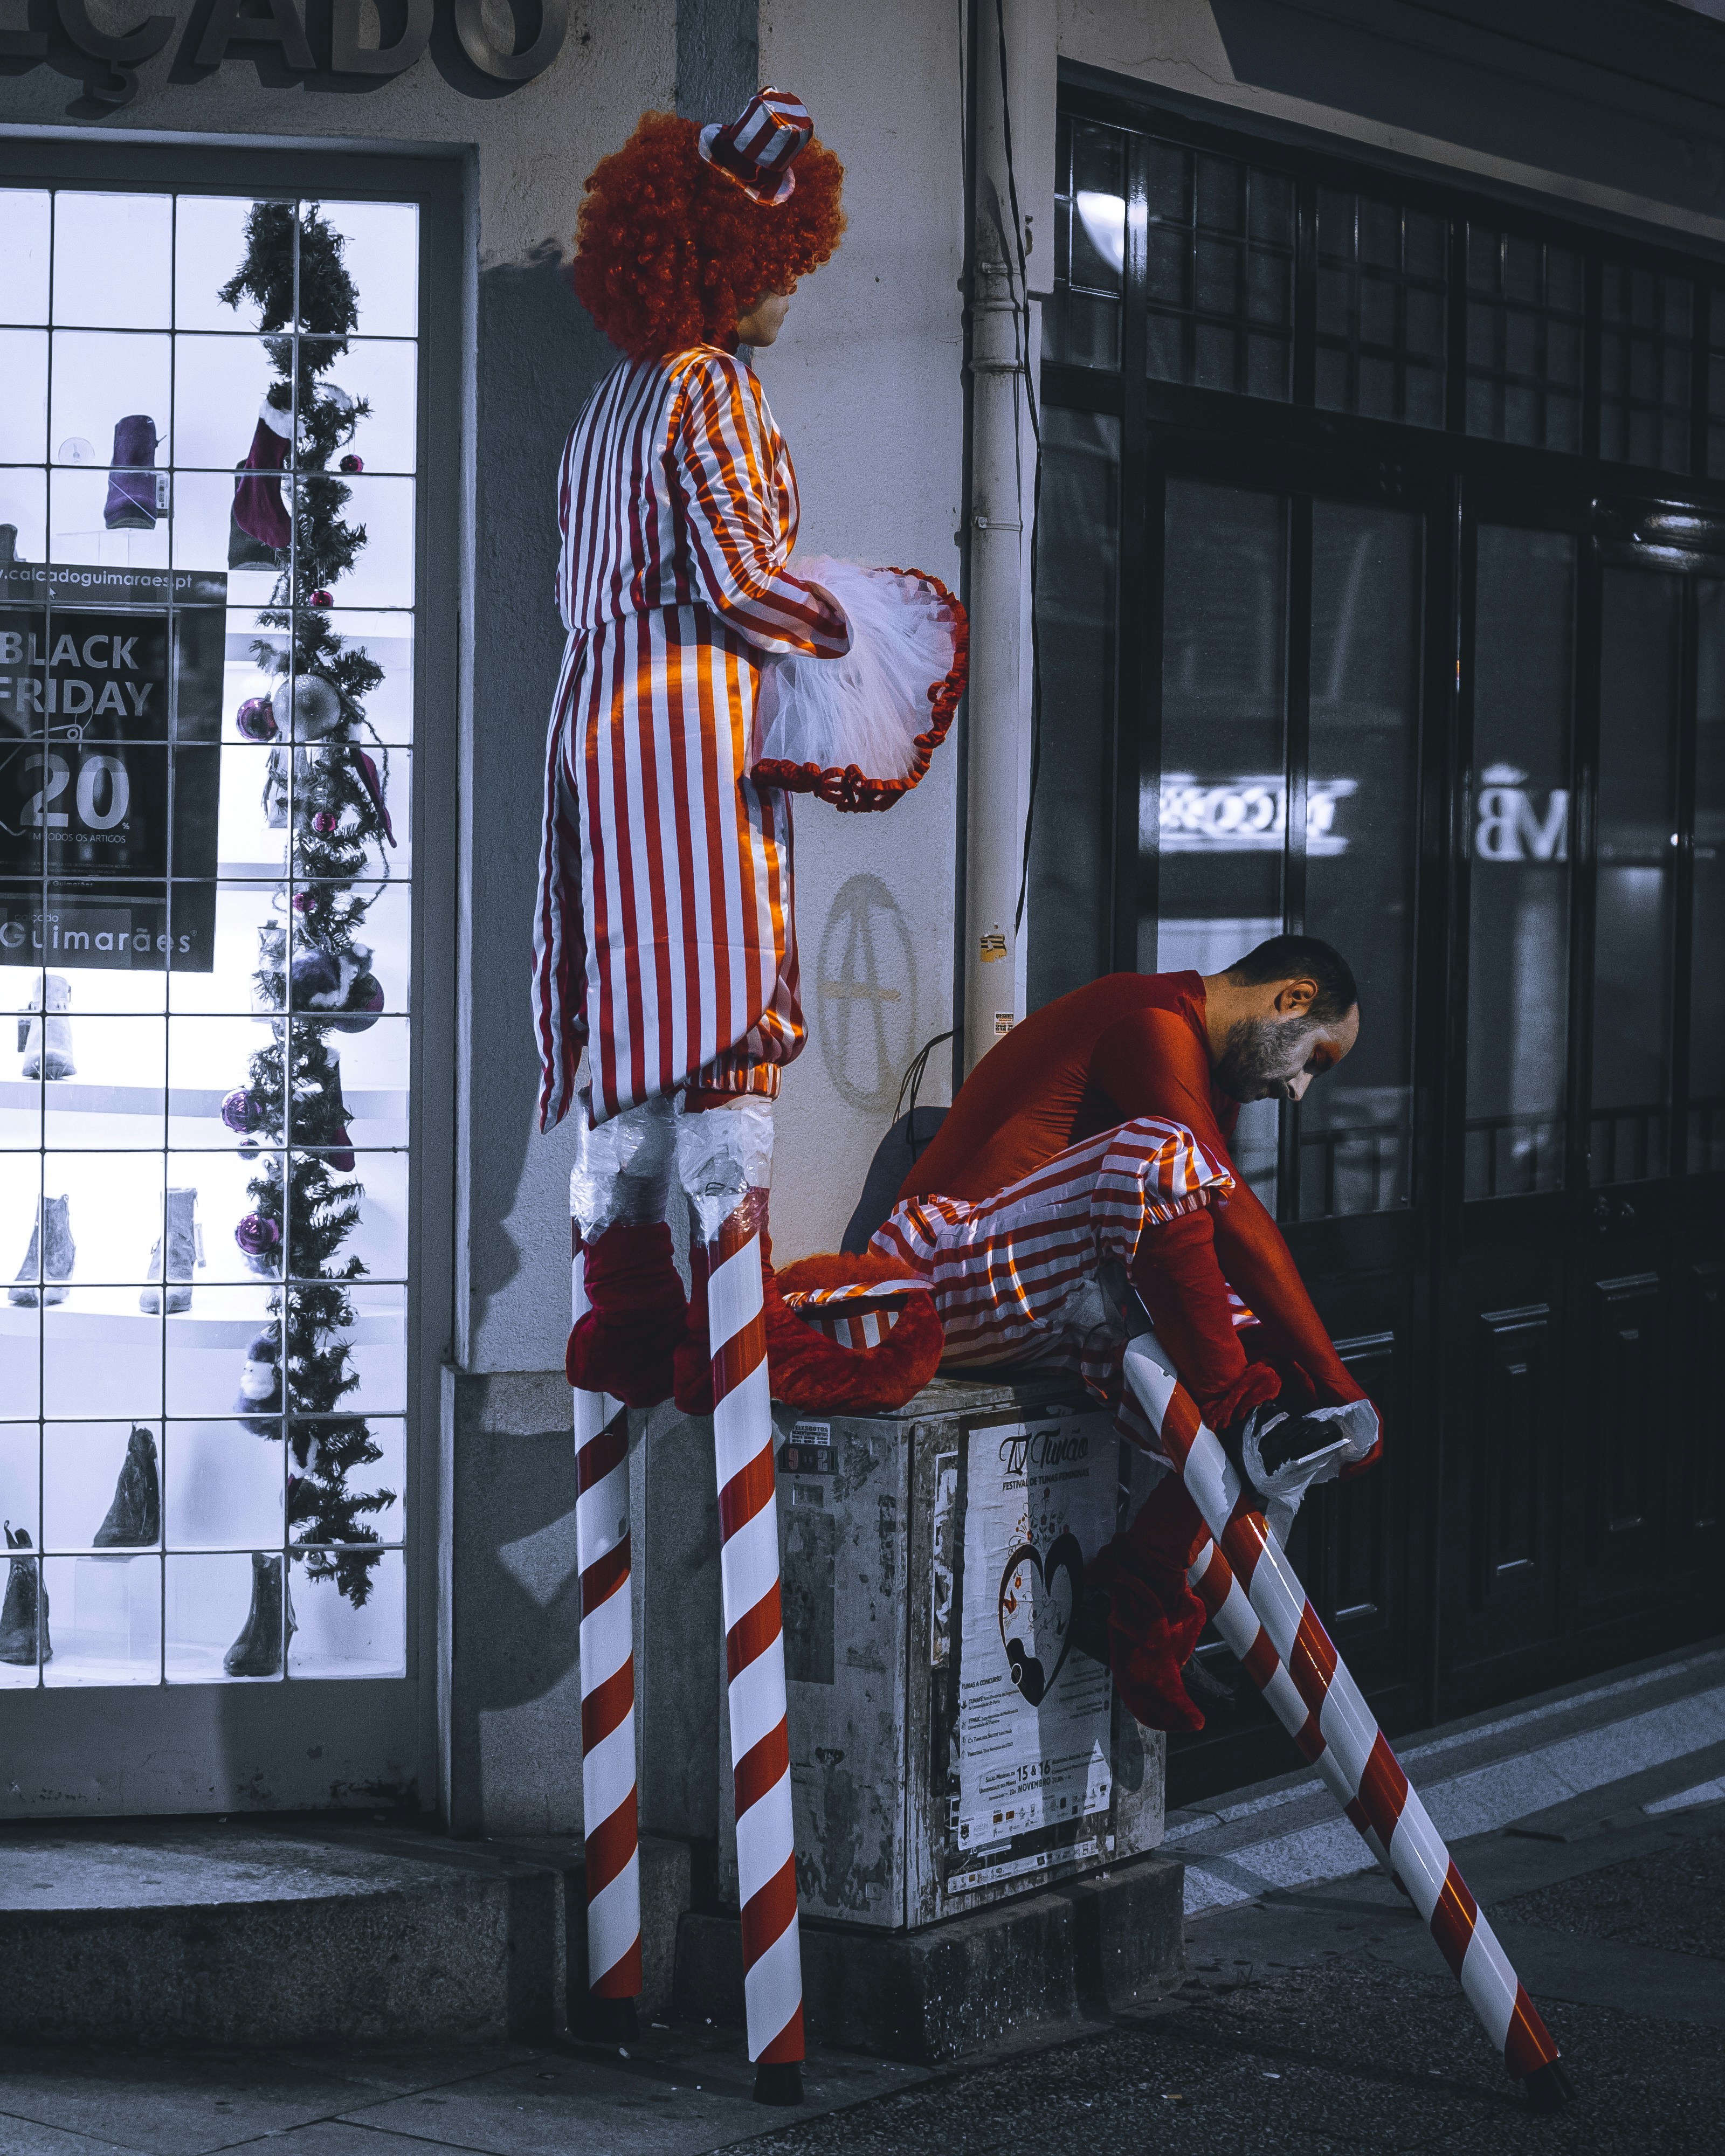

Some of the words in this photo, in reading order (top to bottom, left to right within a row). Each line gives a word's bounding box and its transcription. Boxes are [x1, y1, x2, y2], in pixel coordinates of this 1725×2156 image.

[0, 568, 192, 590] .calcadoguimaraes.pt
[0, 631, 139, 669] BLACK
[44, 833, 73, 842] ODOS
[75, 834, 88, 842] OS
[89, 834, 126, 844] ARTIGOS
[0, 921, 191, 953] Guimarães
[1003, 1478, 1029, 1491] FESTIVAL
[1030, 1476, 1037, 1487] DE
[1039, 1473, 1059, 1484] TUNAS
[962, 1681, 976, 1690] TUNAS
[1017, 1764, 1029, 1782] 15
[1031, 1765, 1036, 1776] &
[1039, 1759, 1051, 1776] 16
[1018, 1777, 1051, 1793] NOVEMBRO
